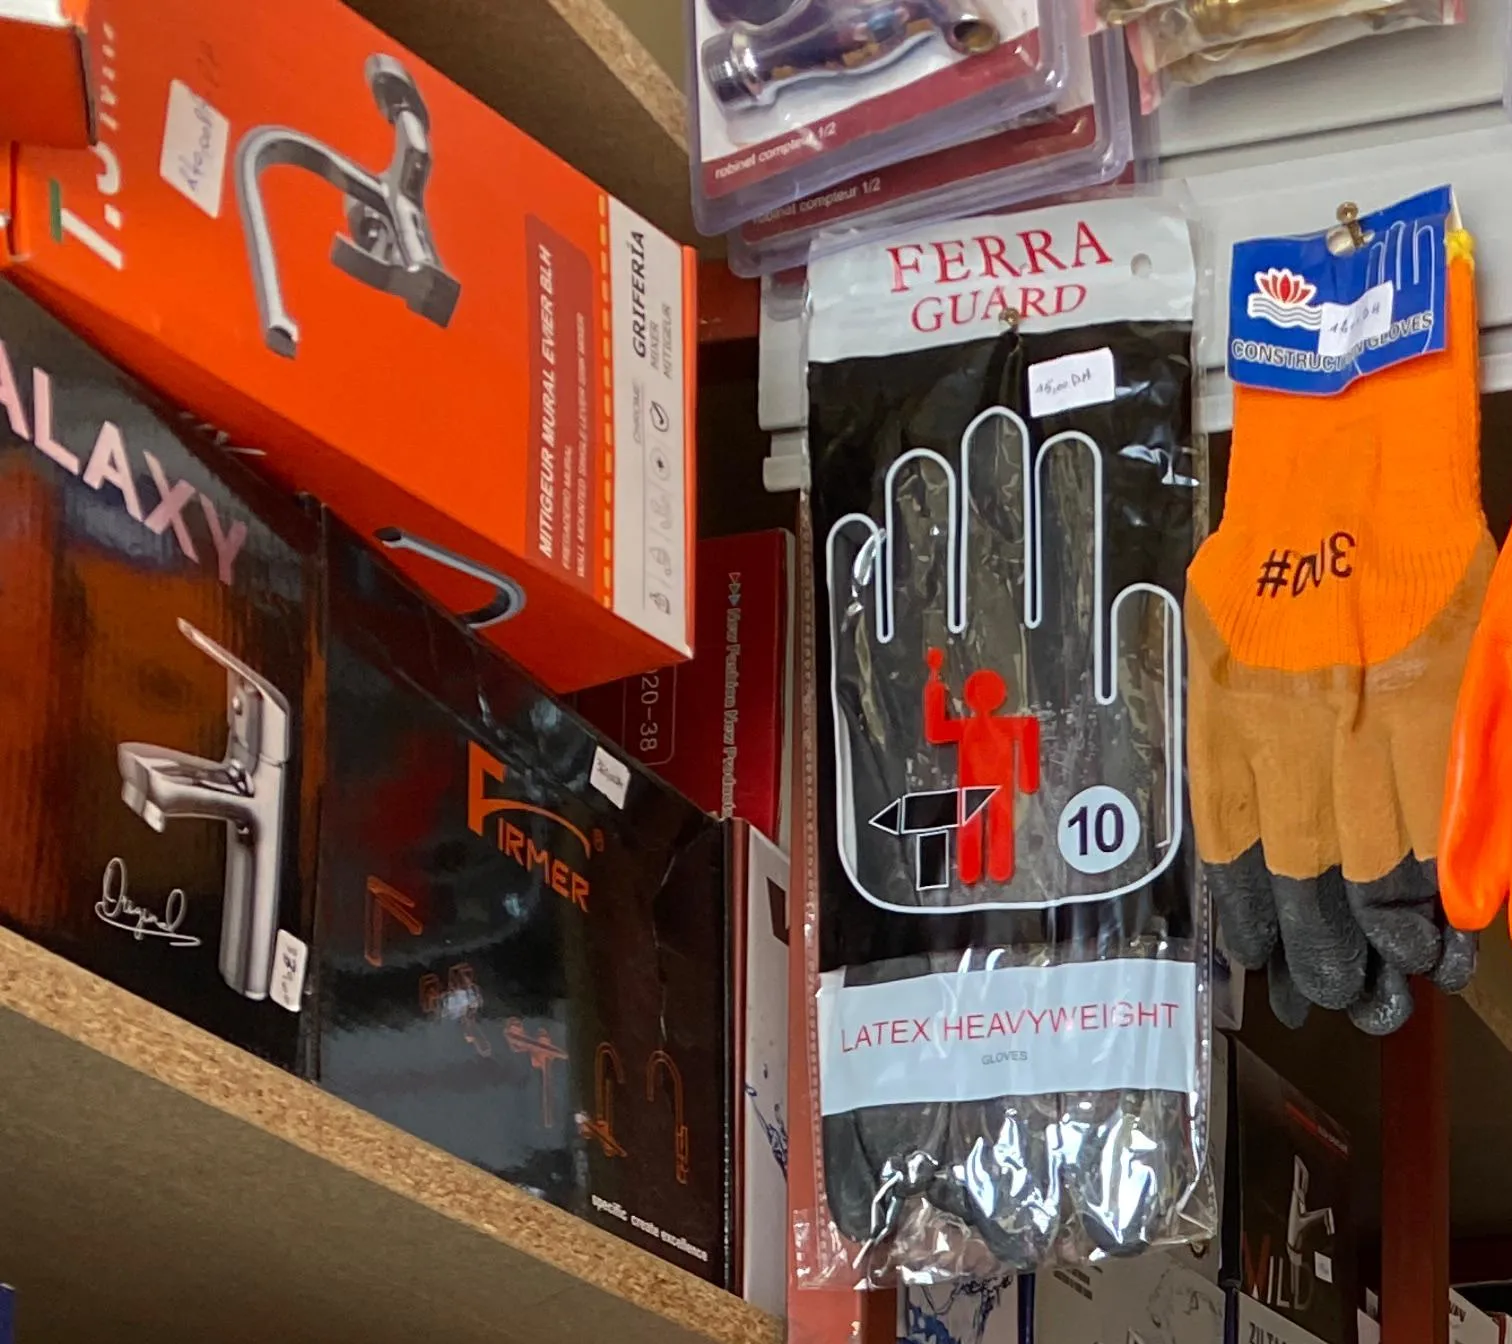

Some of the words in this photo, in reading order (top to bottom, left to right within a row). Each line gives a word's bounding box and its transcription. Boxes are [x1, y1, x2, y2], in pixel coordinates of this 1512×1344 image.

[715, 152, 756, 180] robinet
[816, 121, 836, 141] 1/2
[799, 185, 859, 211] compteur
[862, 176, 881, 193] 1/2
[539, 245, 553, 293] BLH
[886, 220, 1112, 293] FERRA
[626, 230, 646, 358] GRIFERÍA
[911, 283, 1087, 334] GUARD
[539, 296, 554, 360] EVIER
[1370, 312, 1433, 347] GLOVES
[540, 371, 555, 447] MURAL
[539, 449, 554, 557] MITIGEUR
[1068, 803, 1124, 856] 10
[841, 1015, 931, 1054] LATEX
[942, 1002, 1179, 1041] HEAVYWEIGHT
[981, 1050, 1028, 1066] GLOVES
